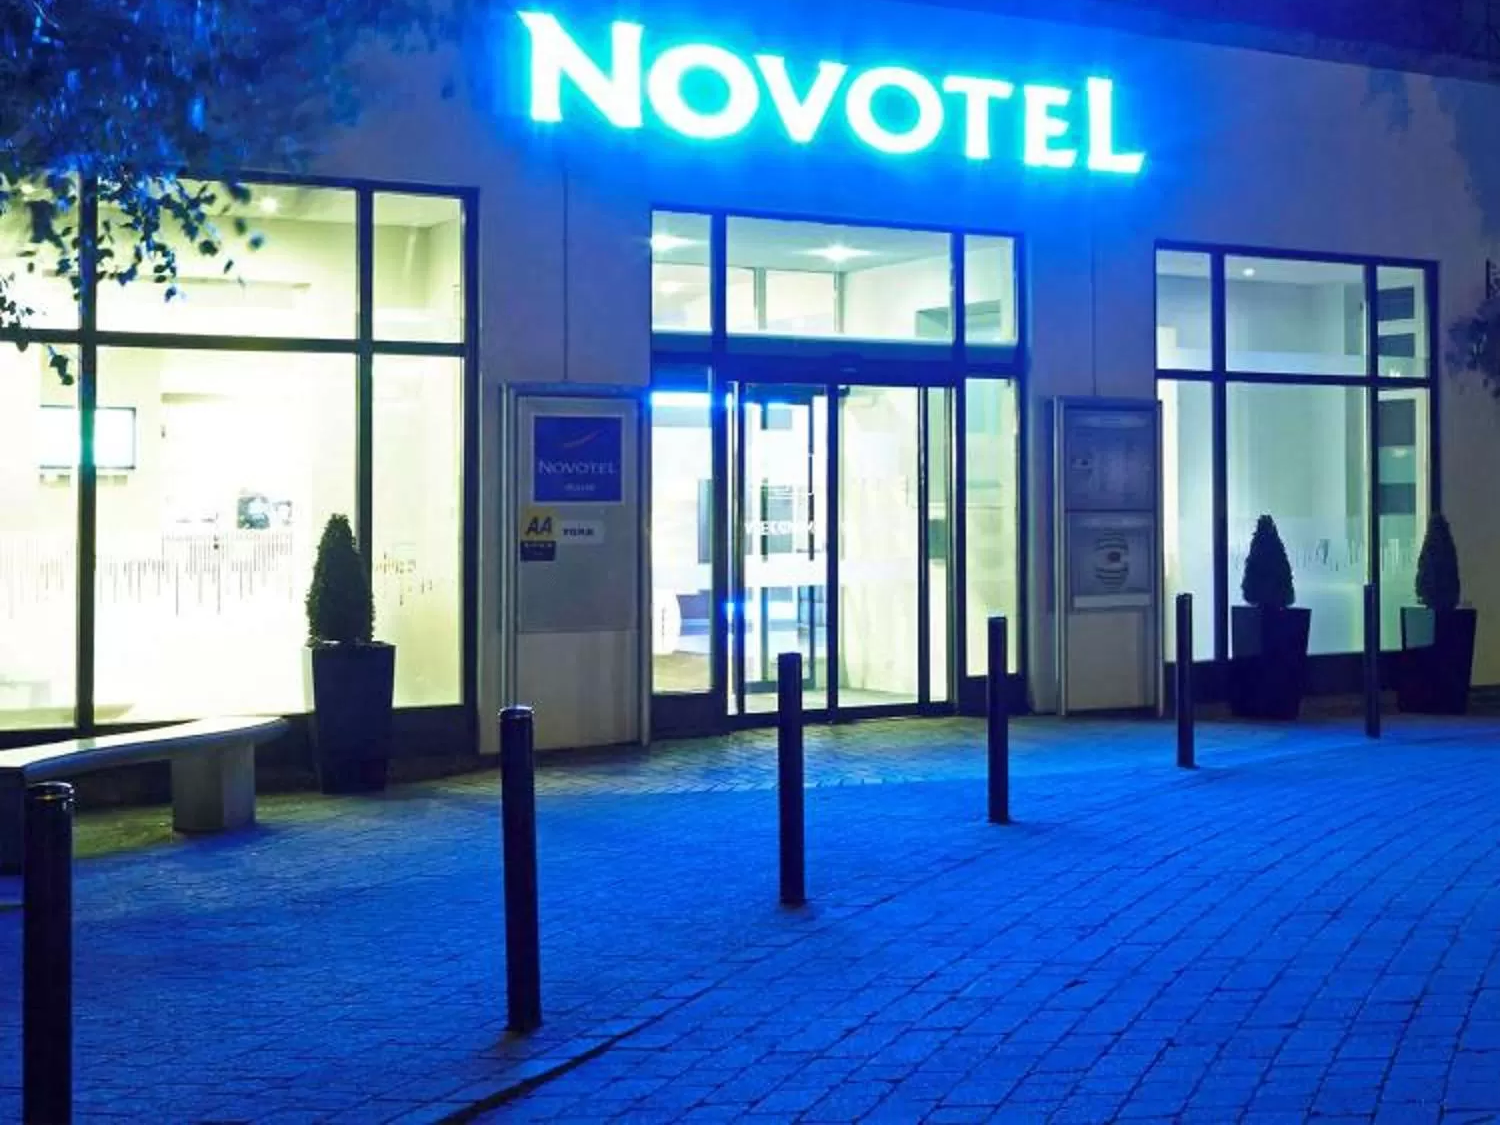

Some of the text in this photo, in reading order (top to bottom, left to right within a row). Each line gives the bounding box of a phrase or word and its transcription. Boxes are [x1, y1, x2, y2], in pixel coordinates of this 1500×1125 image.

[517, 11, 1146, 174] NOVOTEL
[538, 459, 616, 475] NOVOTEL
[524, 516, 553, 536] AA
